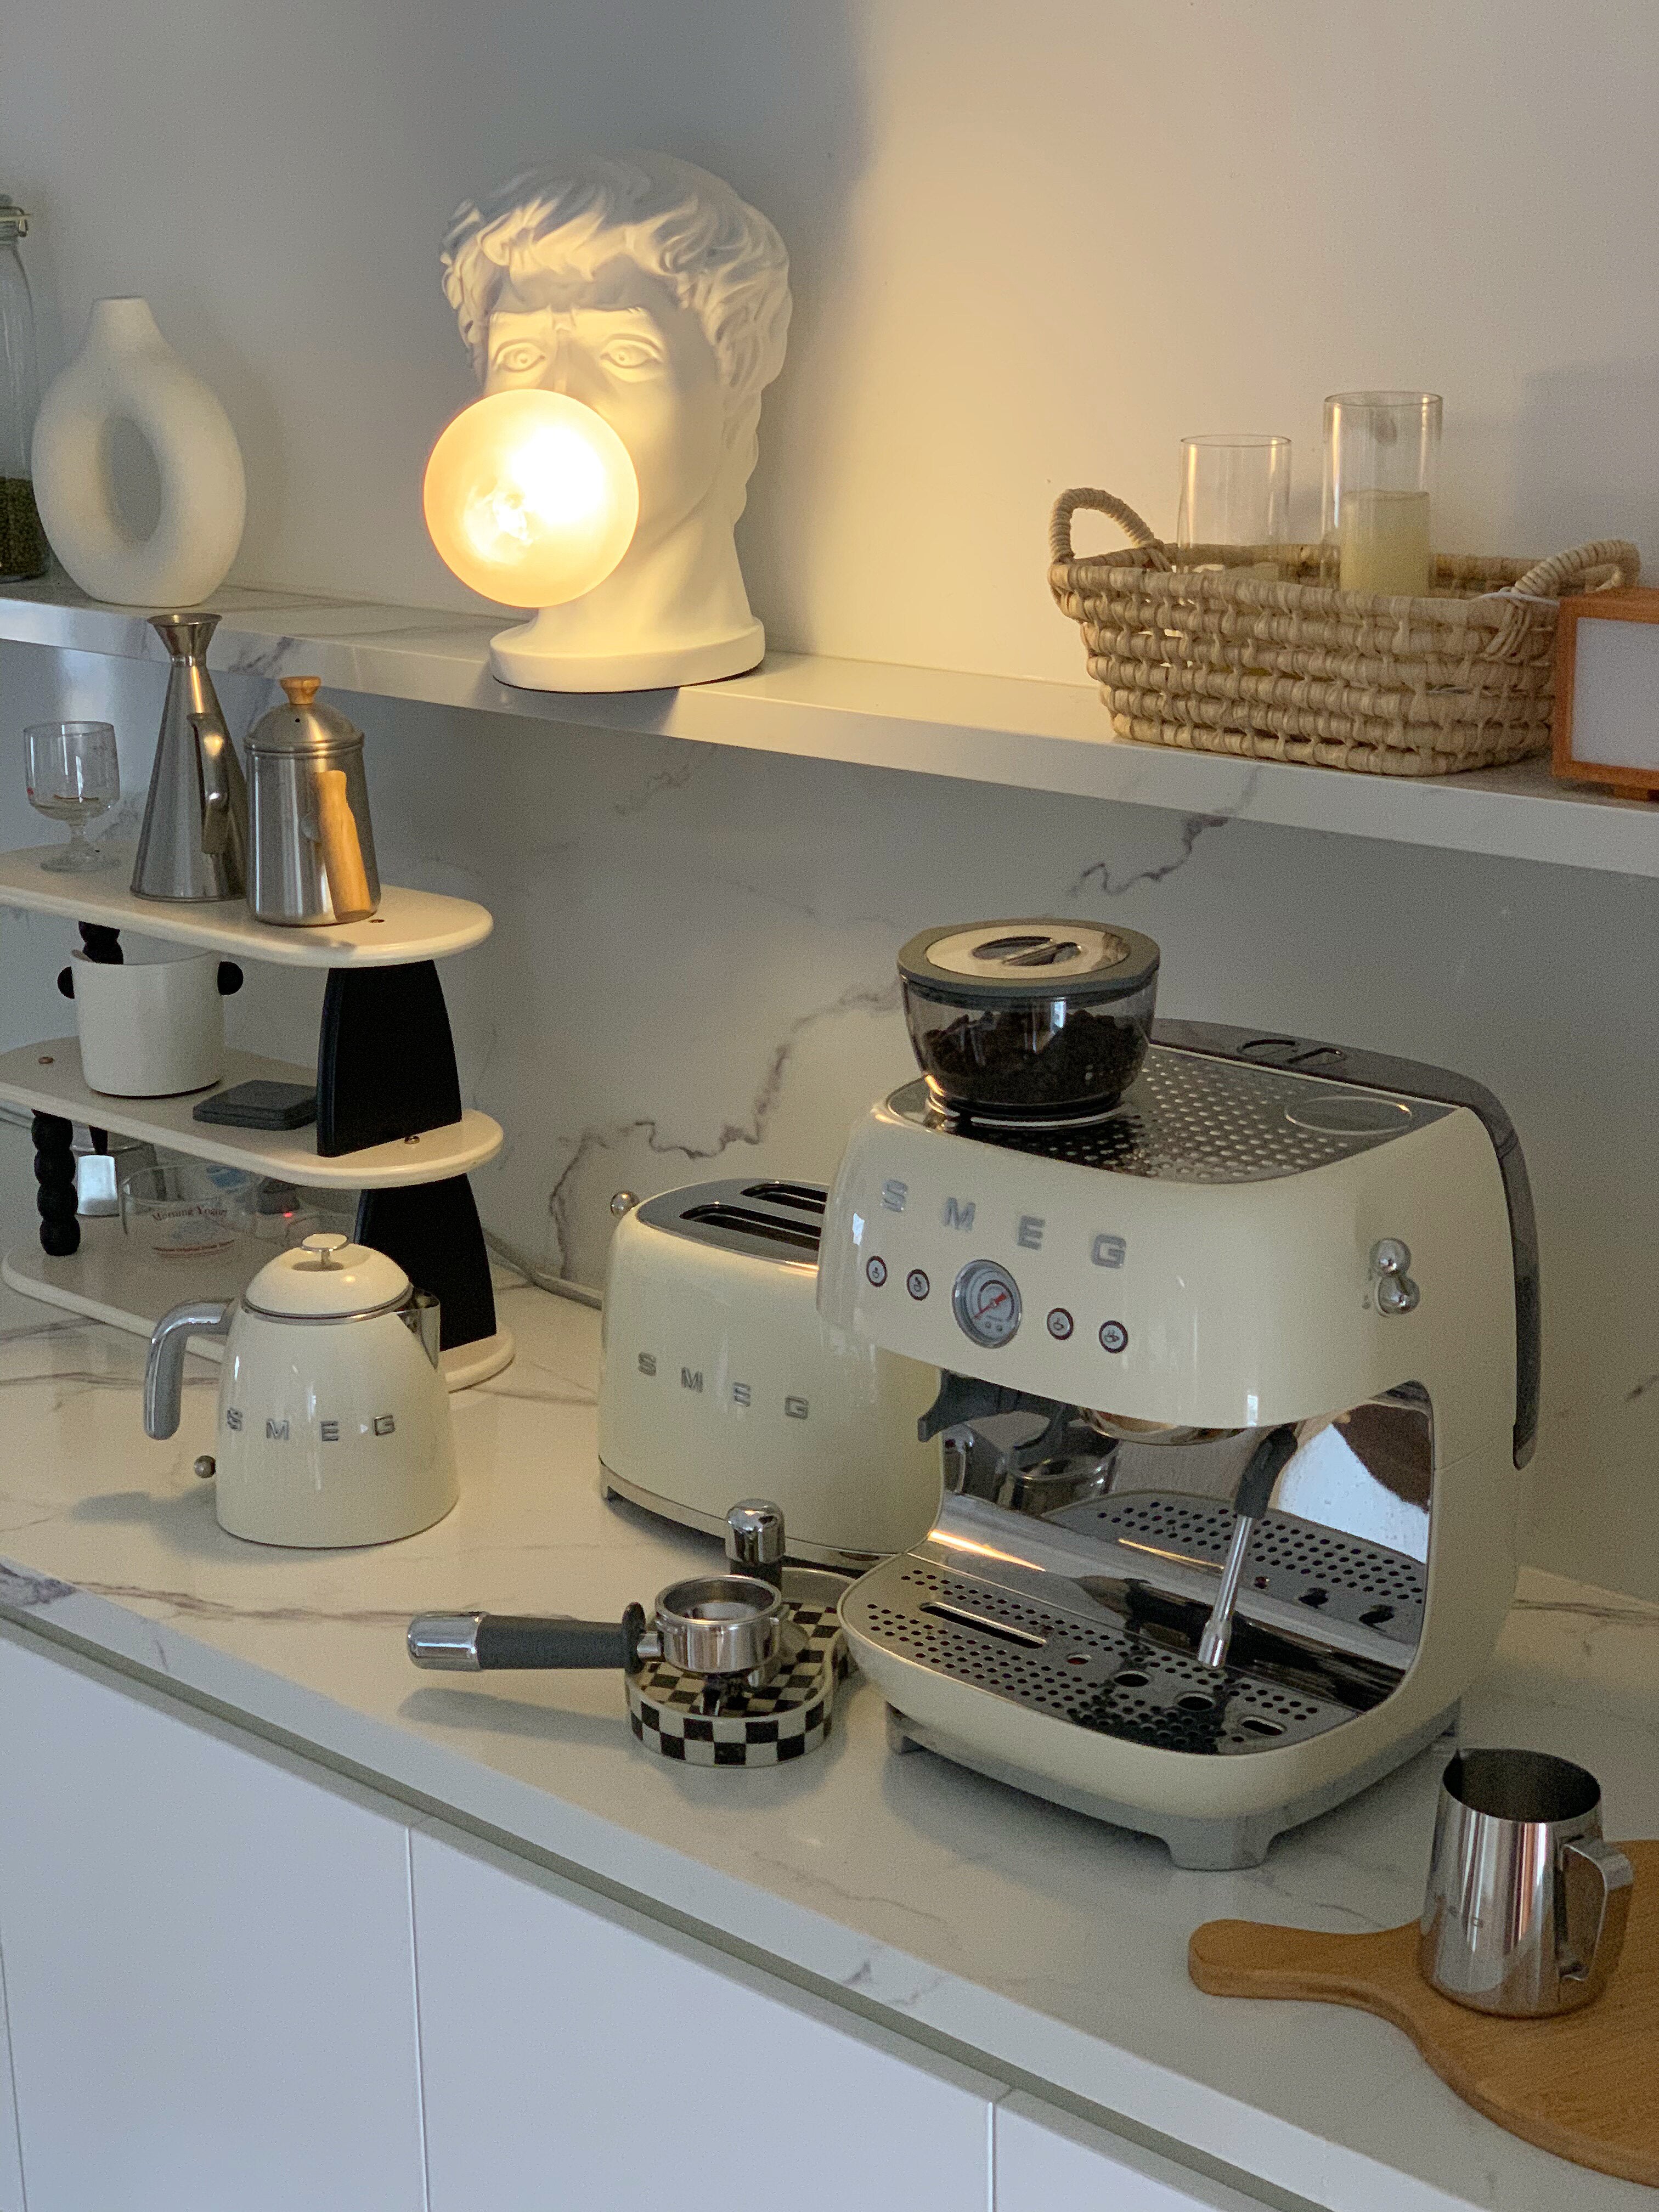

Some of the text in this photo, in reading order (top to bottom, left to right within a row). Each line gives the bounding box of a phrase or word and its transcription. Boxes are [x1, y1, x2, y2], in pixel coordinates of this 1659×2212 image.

[882, 1179, 1127, 1268] SMEG
[637, 1351, 809, 1419] SMEG
[227, 1407, 396, 1441] SMEG
